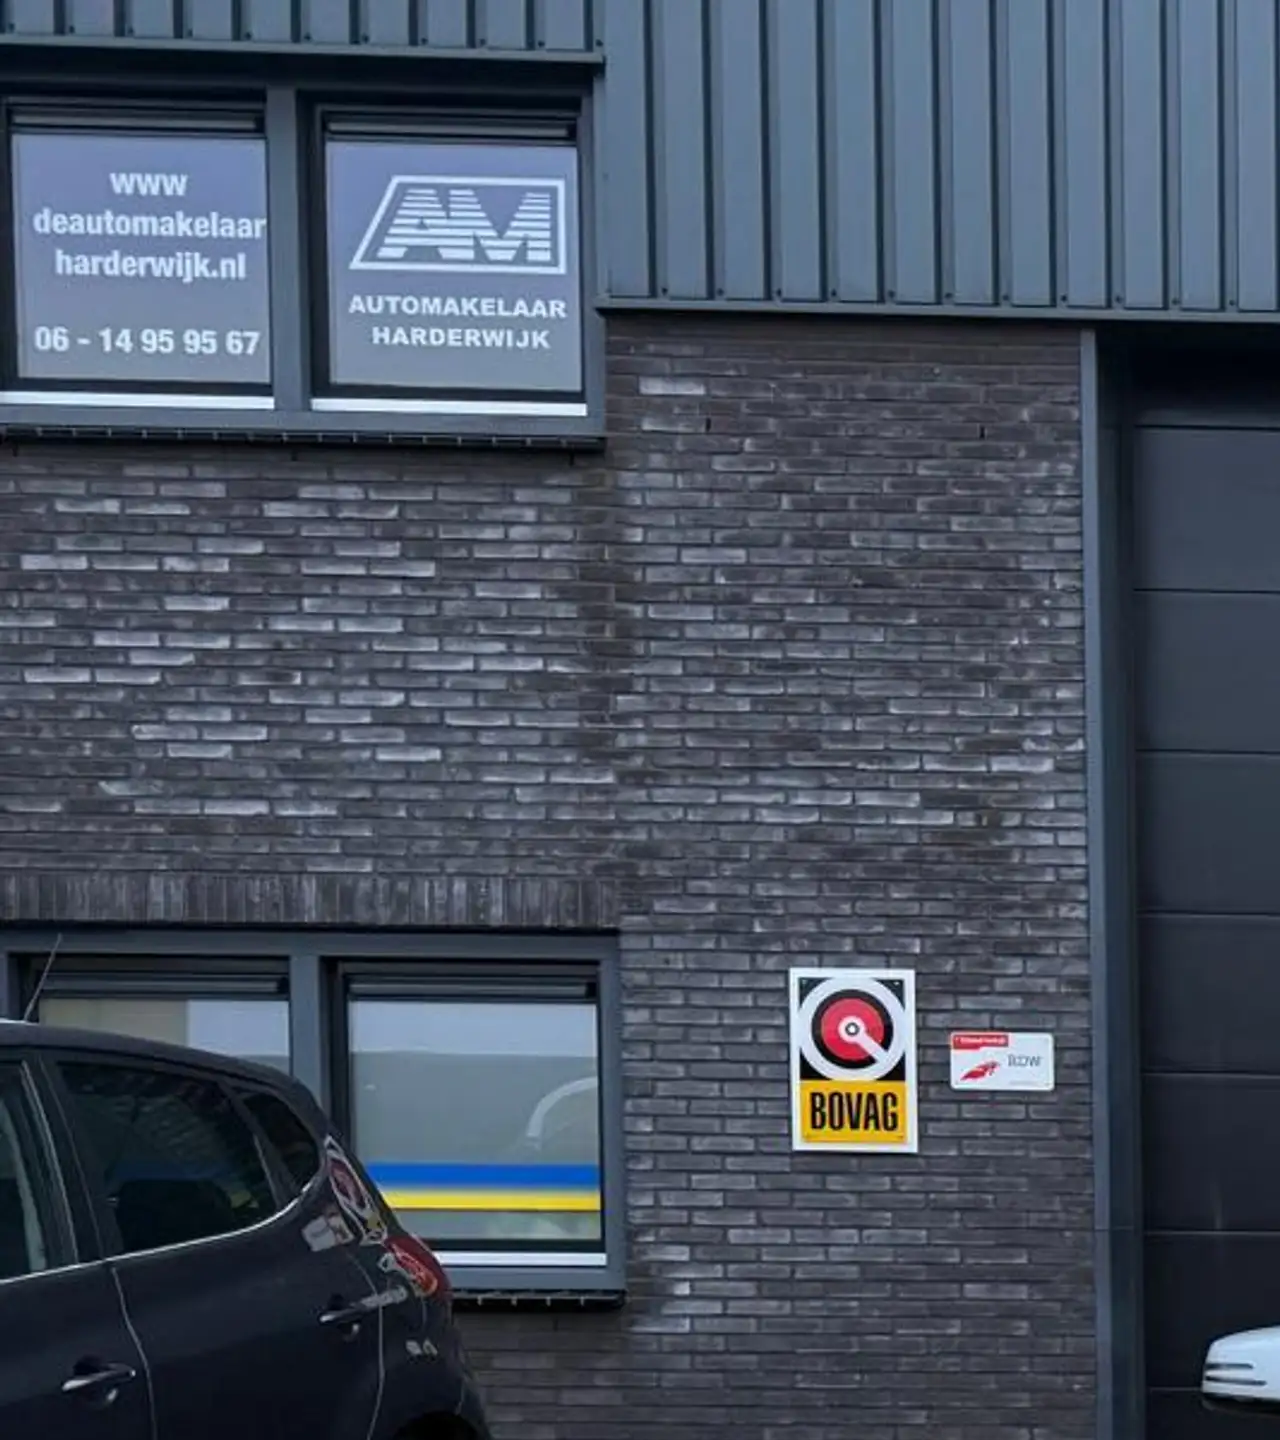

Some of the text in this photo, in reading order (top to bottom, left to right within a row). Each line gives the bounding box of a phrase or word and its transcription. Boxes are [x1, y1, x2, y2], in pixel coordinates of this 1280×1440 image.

[109, 172, 188, 197] www
[33, 207, 267, 240] deautomakelaar
[376, 188, 552, 261] AM
[55, 249, 247, 283] harderwijk.nl
[348, 294, 567, 319] AUTOMAKELAAR
[35, 326, 69, 351] 06
[99, 329, 132, 353] 14
[141, 330, 175, 354] 95
[184, 330, 218, 355] 95
[226, 331, 261, 356] 67
[372, 325, 551, 349] HARDERWIJK
[810, 1091, 898, 1132] BOVAG
